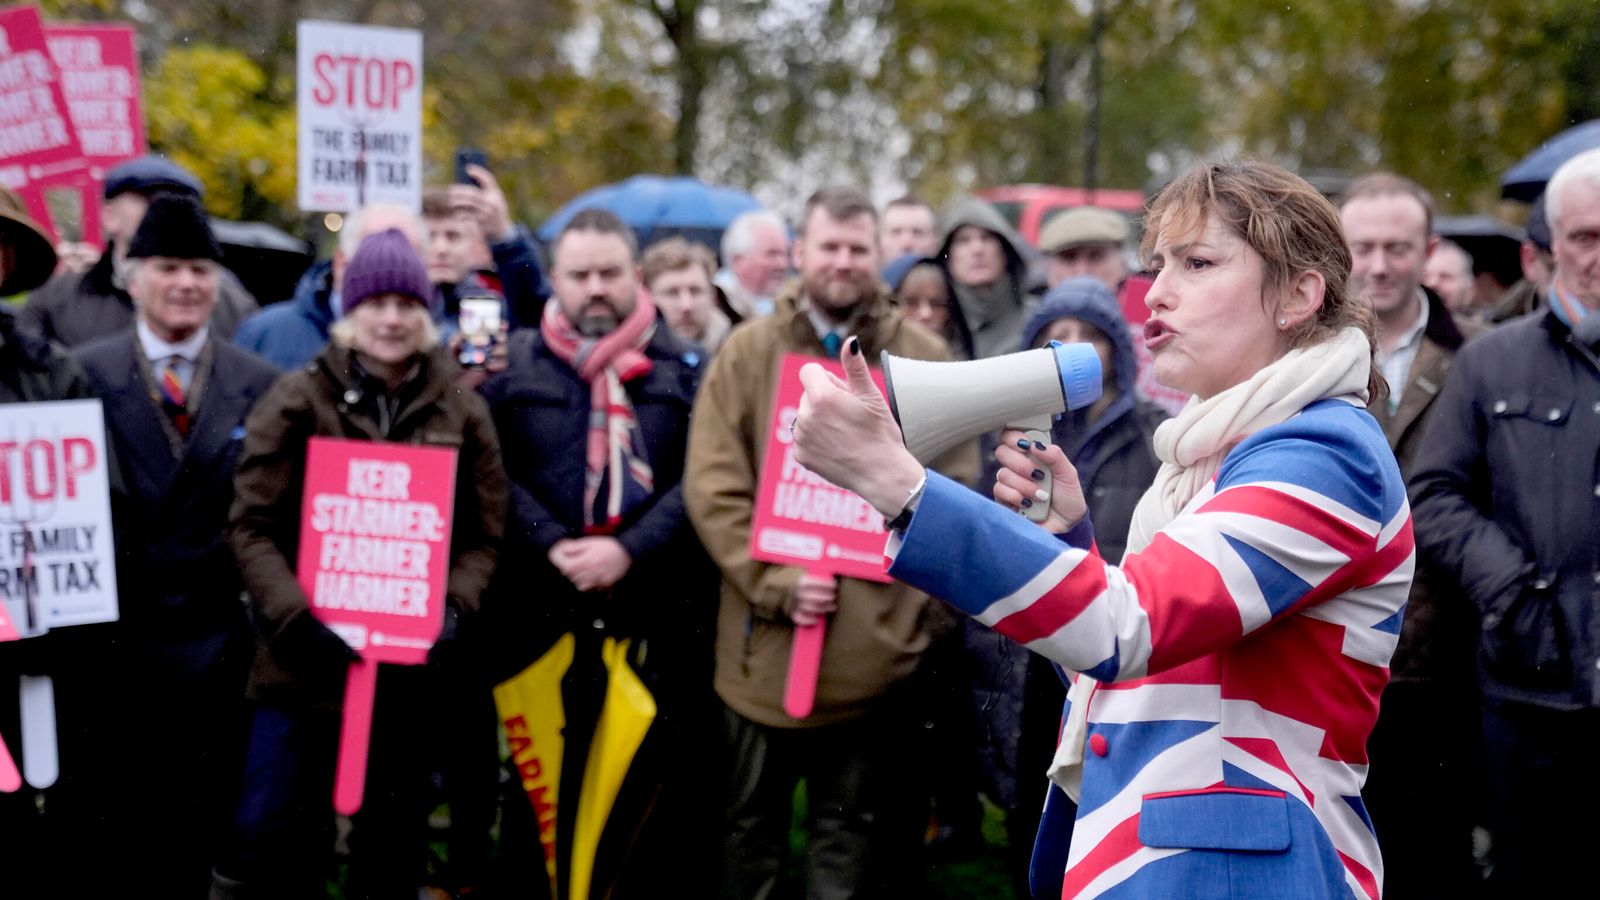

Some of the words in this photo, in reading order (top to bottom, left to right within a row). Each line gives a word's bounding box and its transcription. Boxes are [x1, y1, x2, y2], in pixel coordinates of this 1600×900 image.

[313, 52, 415, 110] STOP
[312, 128, 343, 151] THE
[352, 130, 411, 154] FAMILY
[312, 158, 366, 183] FARM
[375, 161, 410, 186] TAX
[0, 437, 97, 505] TOP
[347, 459, 411, 500] KEIR
[311, 492, 444, 542] STARMER:
[9, 526, 97, 556] FAMILY
[320, 533, 431, 578] FARMER
[0, 566, 40, 600] RM
[48, 560, 102, 595] TAX
[313, 570, 430, 617] HARMER
